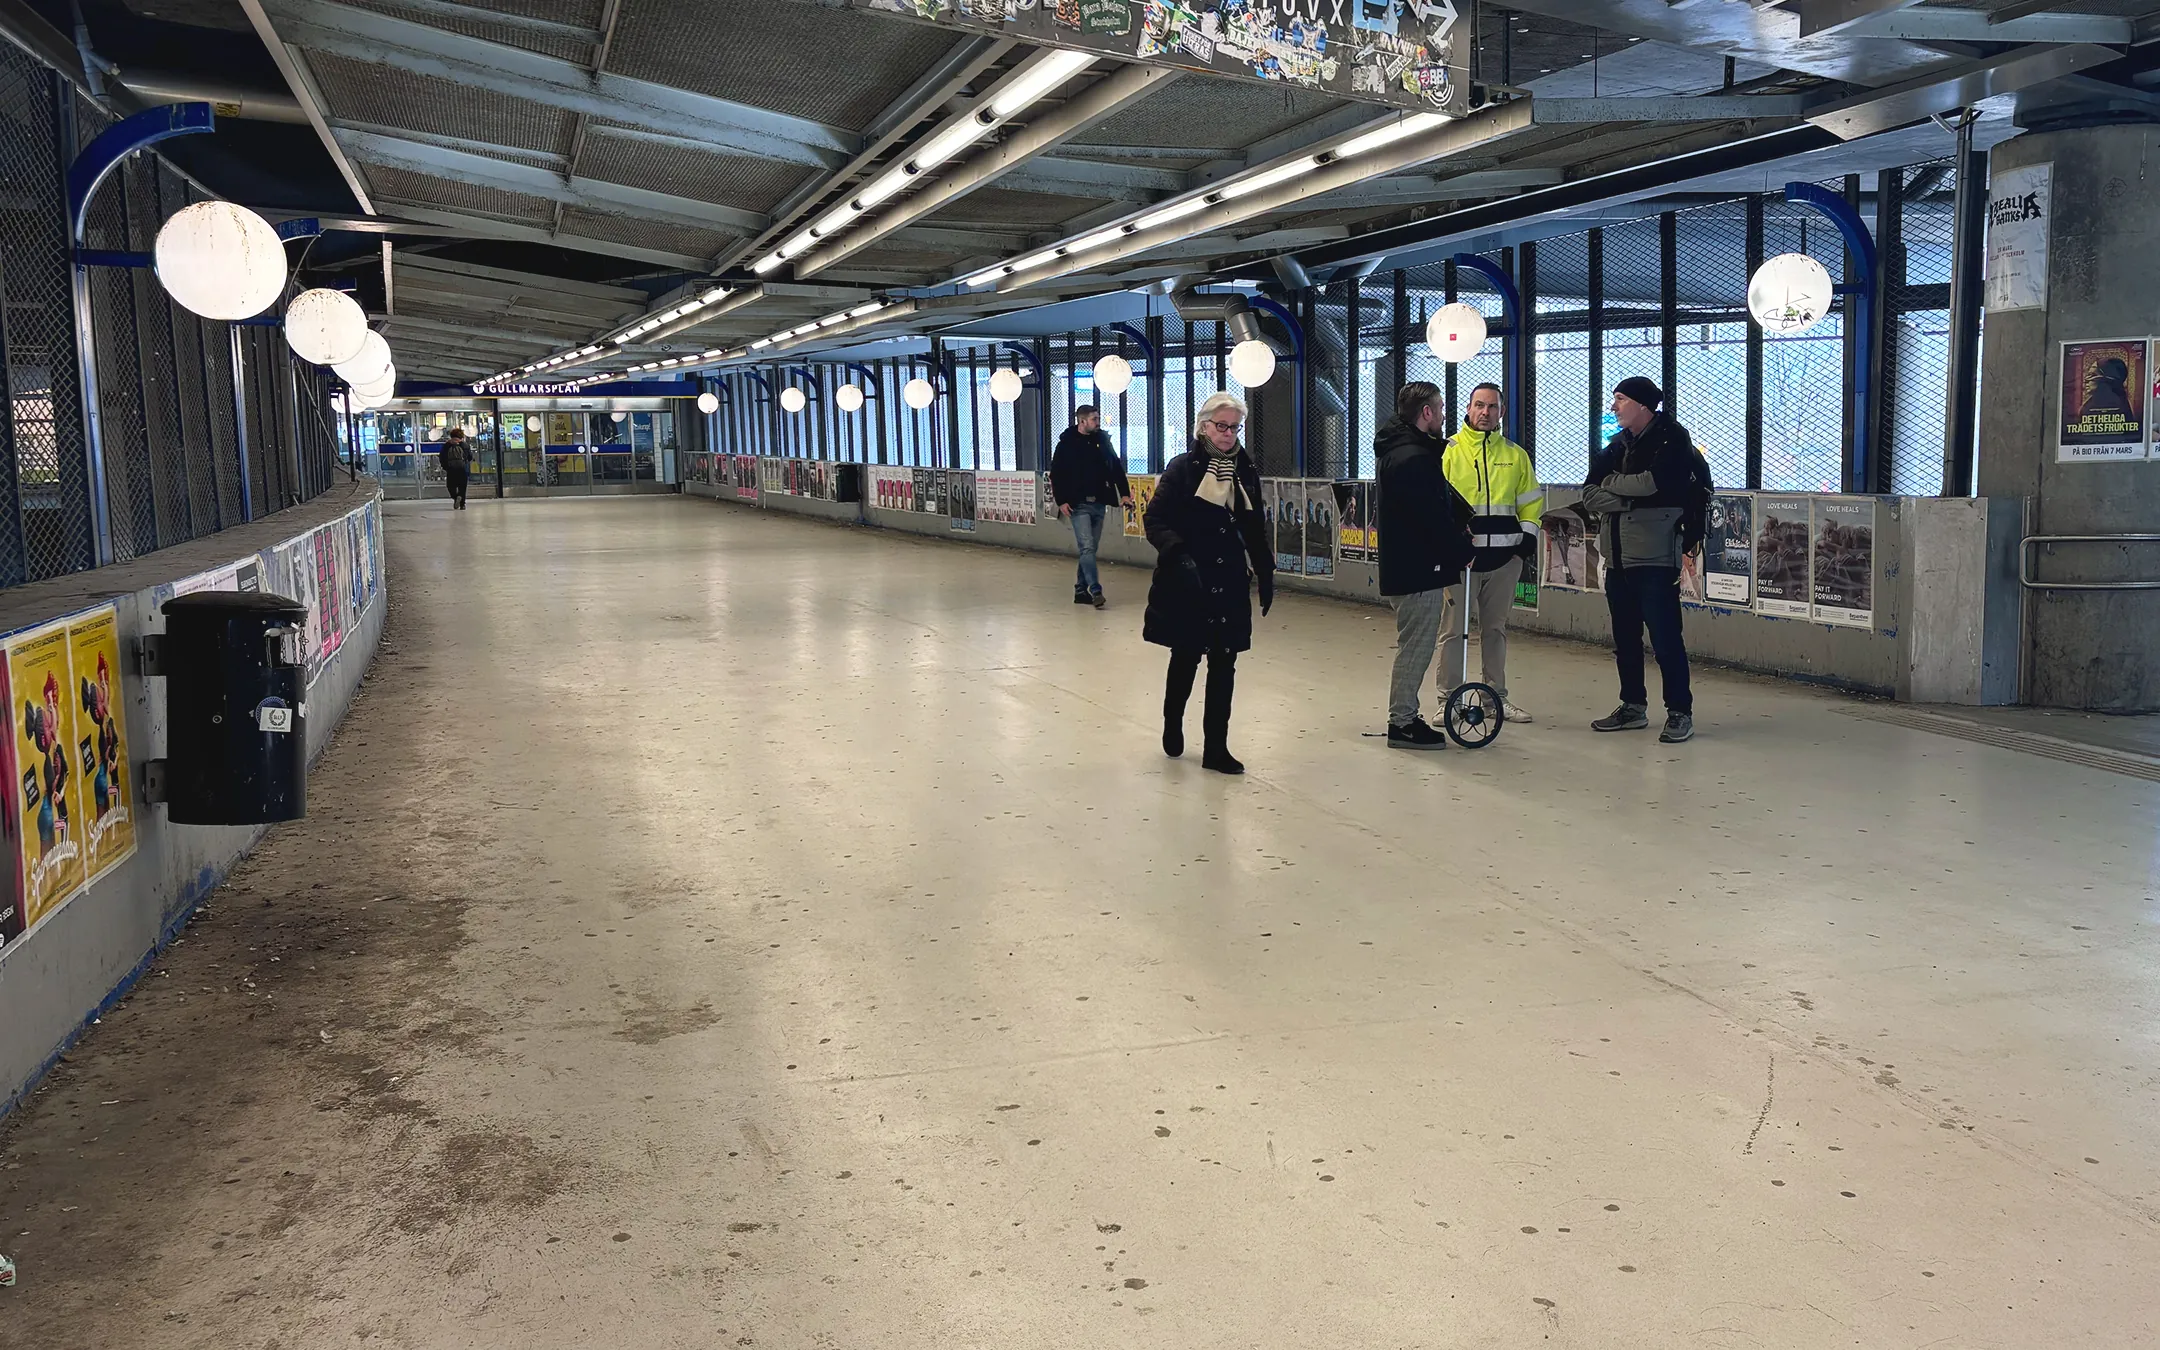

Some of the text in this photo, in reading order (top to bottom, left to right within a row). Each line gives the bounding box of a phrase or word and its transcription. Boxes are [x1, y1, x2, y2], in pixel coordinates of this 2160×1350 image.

[1183, 35, 1211, 59] ULTRAS
[489, 384, 580, 394] GULLMARSPLAN
[2082, 414, 2125, 424] DET HELIGA
[2104, 422, 2139, 432] FRUKTER
[2072, 447, 2080, 455] PÅ
[2093, 446, 2109, 455] FRÅN
[2115, 446, 2133, 454] MARS
[1767, 502, 1781, 510] LOVE
[1842, 505, 1859, 513] HEALS
[1758, 586, 1783, 595] FORWARD
[1815, 593, 1842, 601] FORWARD
